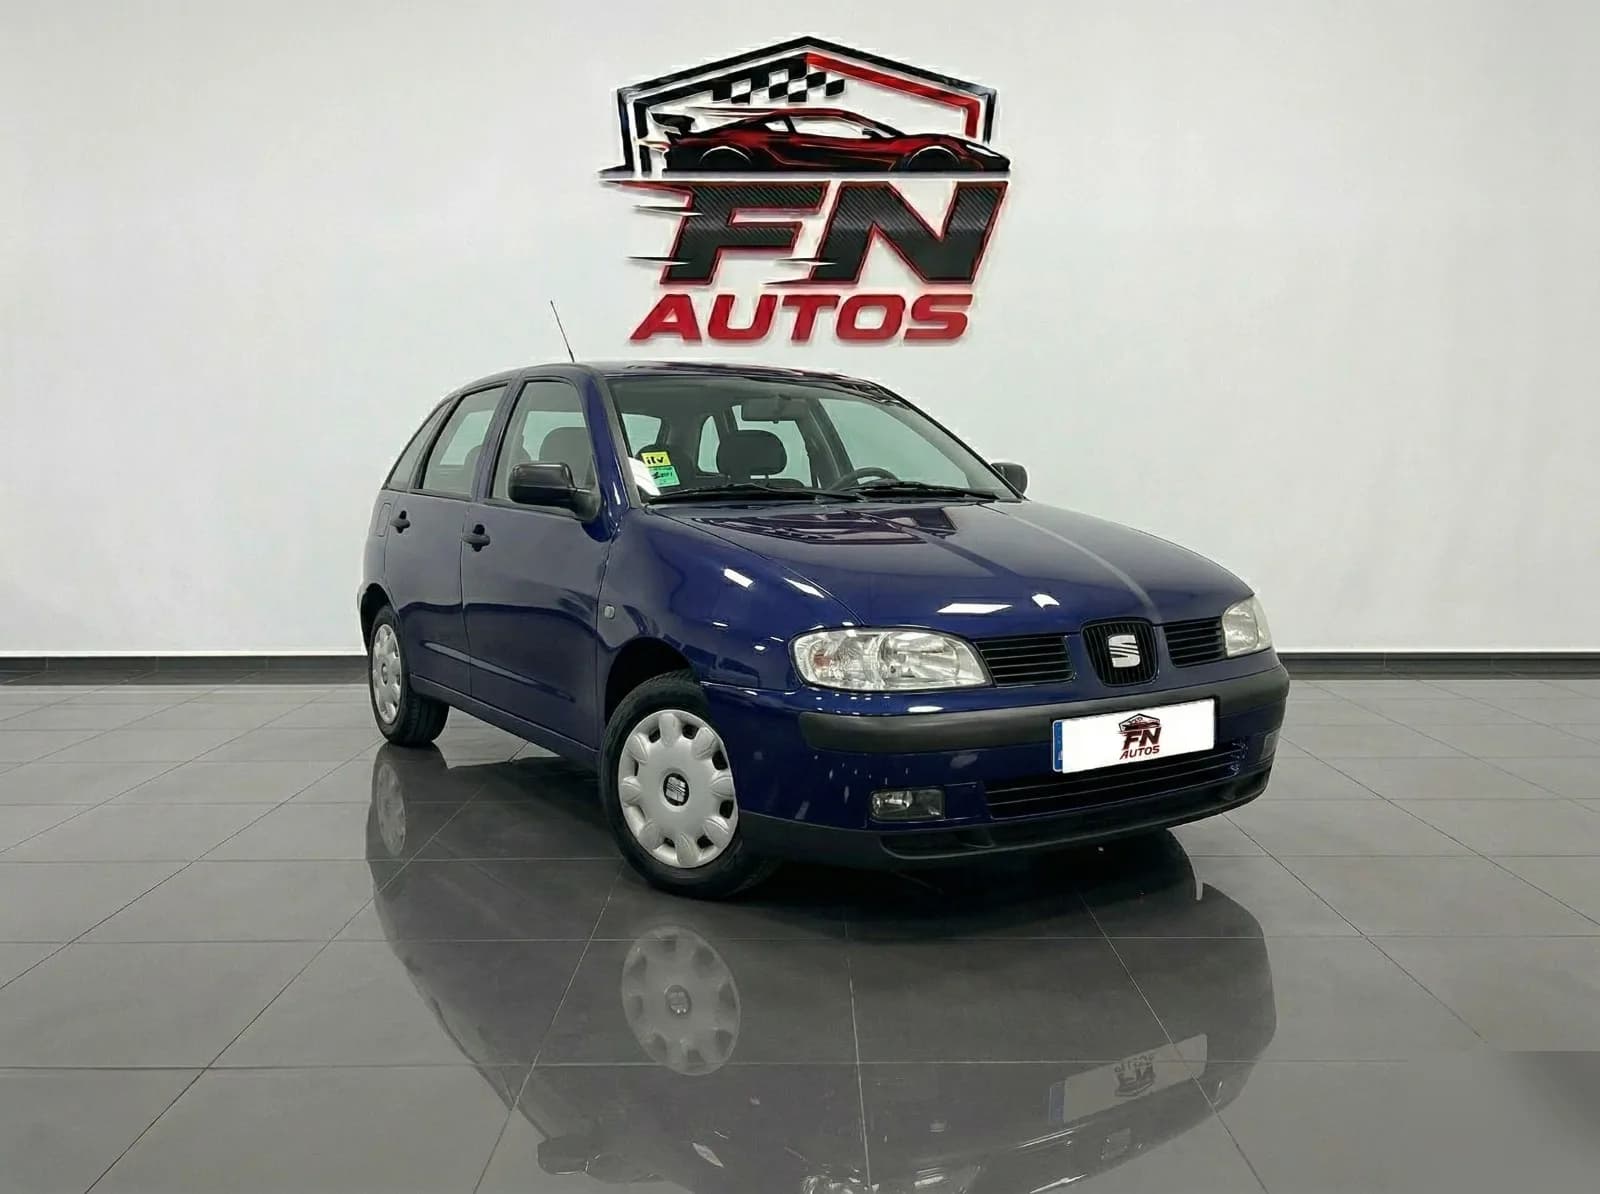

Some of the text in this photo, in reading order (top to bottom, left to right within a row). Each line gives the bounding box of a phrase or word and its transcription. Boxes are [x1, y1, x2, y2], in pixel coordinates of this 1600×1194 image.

[659, 181, 1009, 285] FN
[630, 293, 974, 342] AUTOS
[1119, 745, 1160, 760] AUTOS
[1121, 727, 1162, 751] FN
